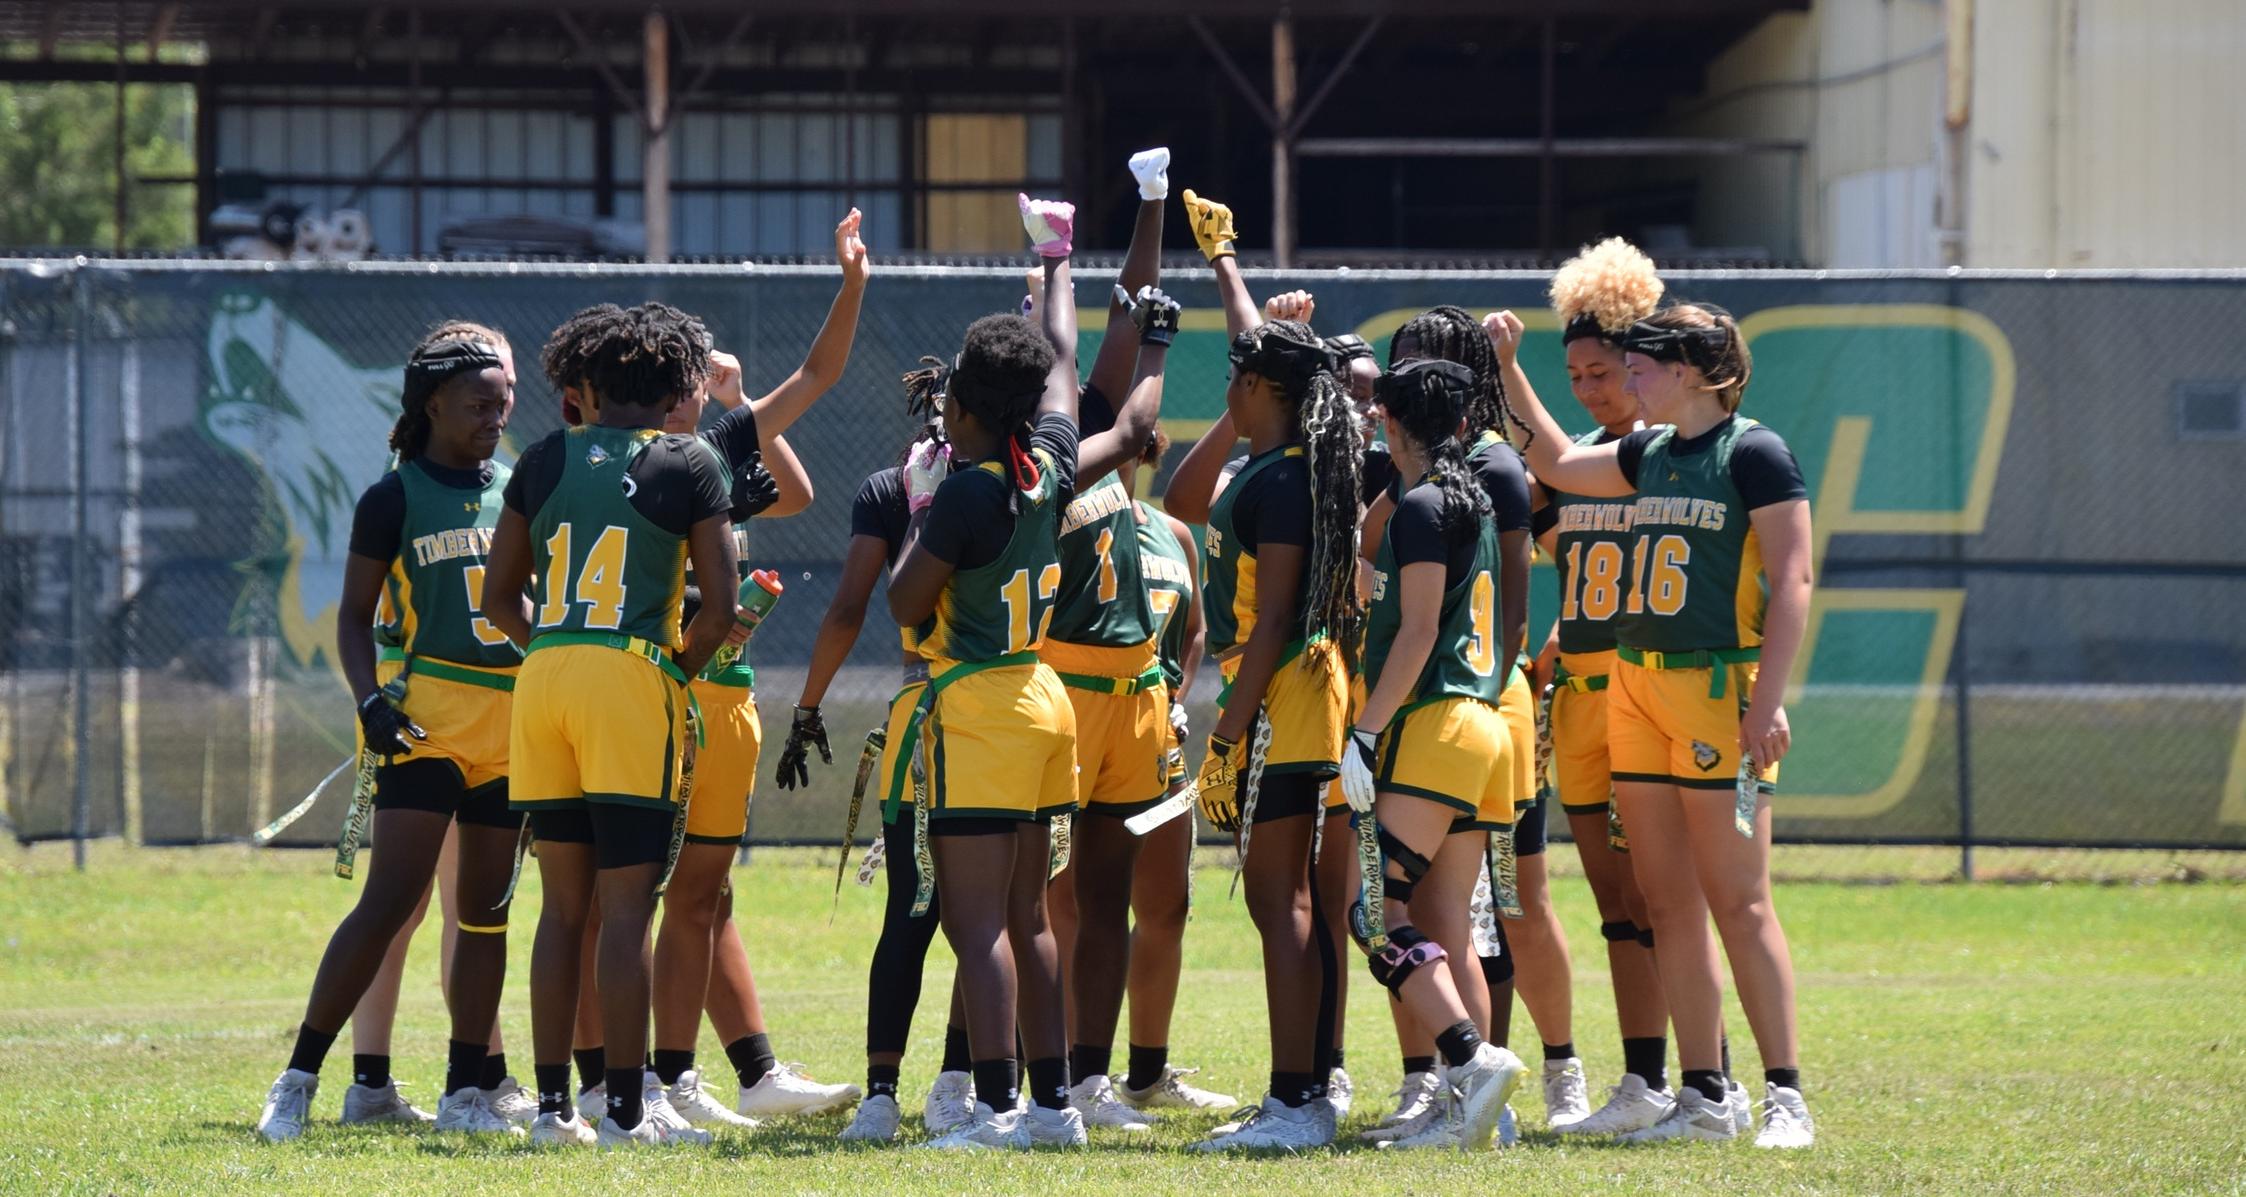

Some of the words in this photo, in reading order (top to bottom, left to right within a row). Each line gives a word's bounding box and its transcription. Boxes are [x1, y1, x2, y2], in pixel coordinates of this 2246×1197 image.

[537, 522, 629, 630] 14
[1001, 562, 1061, 656] 12
[1094, 526, 1118, 605] 1
[1562, 541, 1624, 621] 18
[1626, 534, 1691, 616] 16
[1148, 588, 1181, 656] 7
[1465, 569, 1496, 678] 9
[1358, 818, 1384, 928] TIMBERWOLVES
